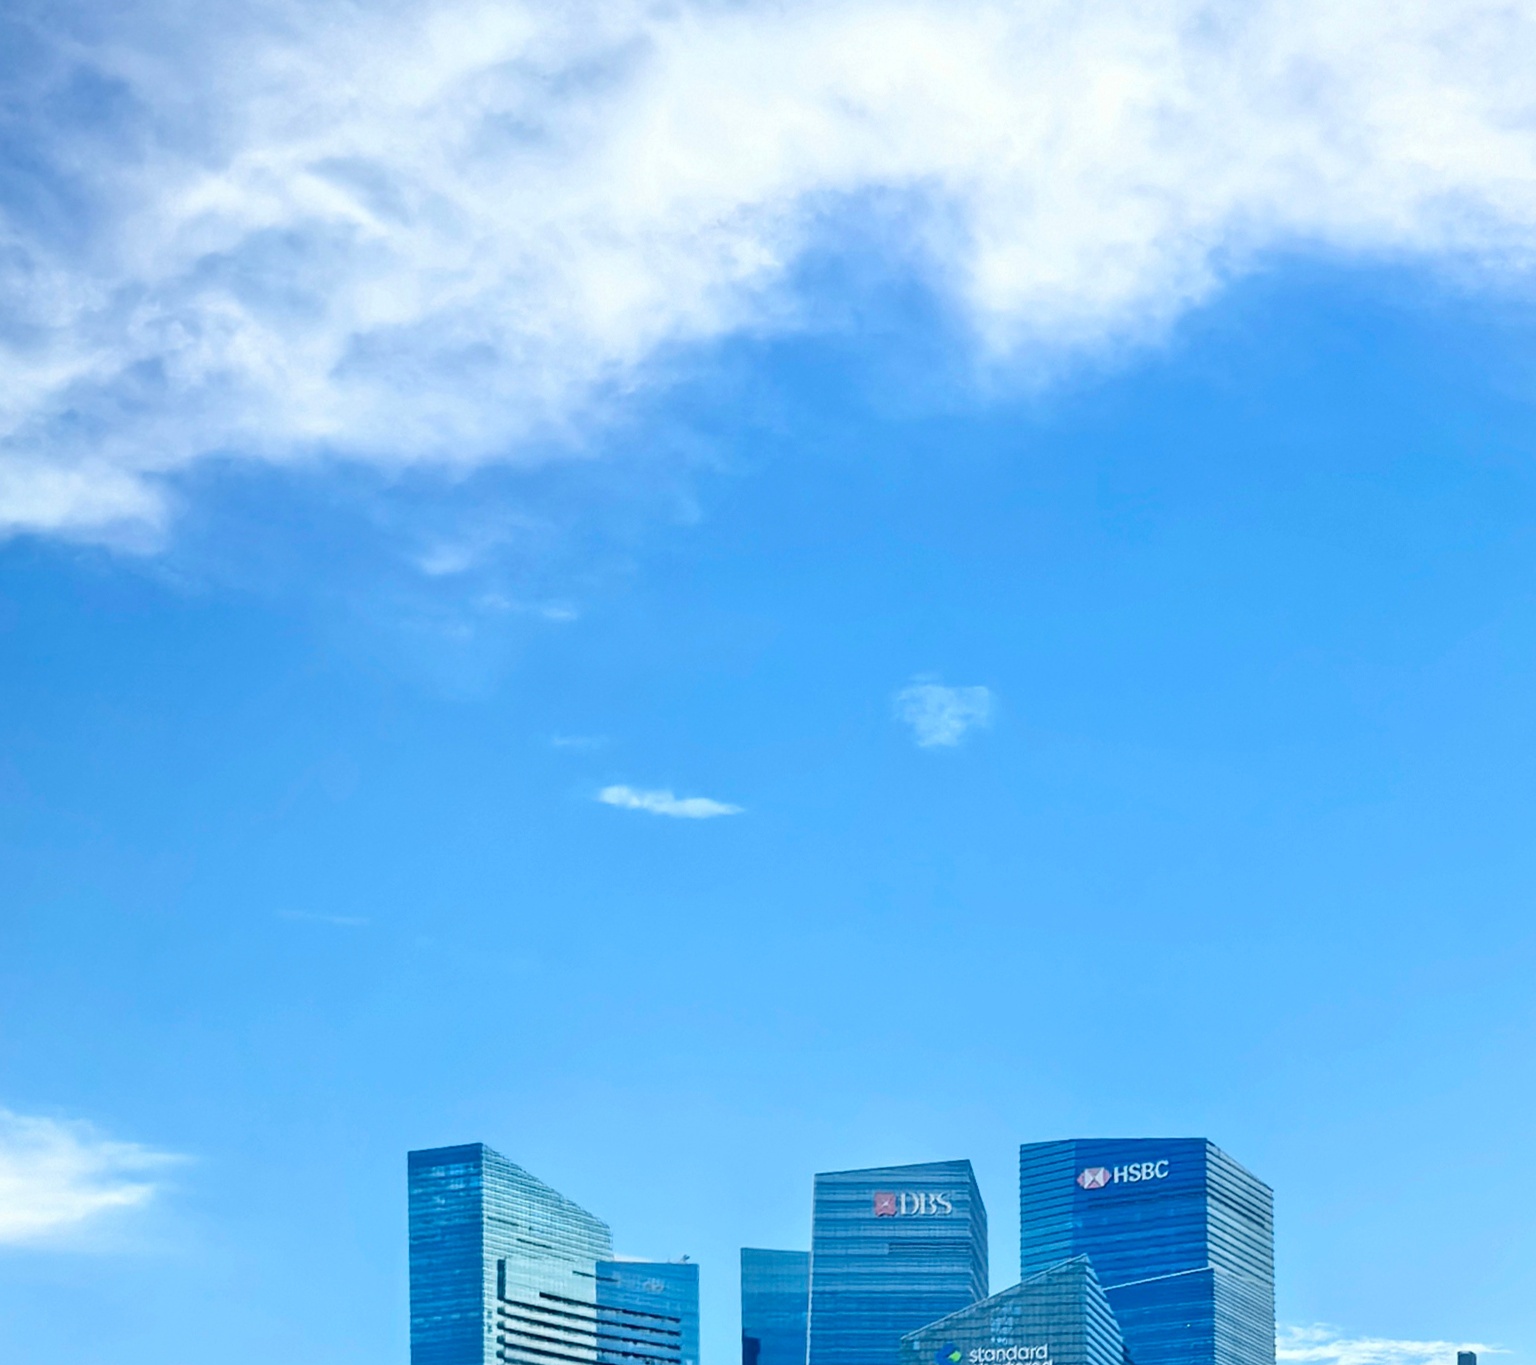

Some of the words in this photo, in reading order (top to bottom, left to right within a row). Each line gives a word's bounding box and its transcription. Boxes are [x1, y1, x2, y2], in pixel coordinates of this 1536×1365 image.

[1113, 1160, 1169, 1184] HSBC
[900, 1192, 953, 1216] DBS
[969, 1344, 1049, 1363] standard
